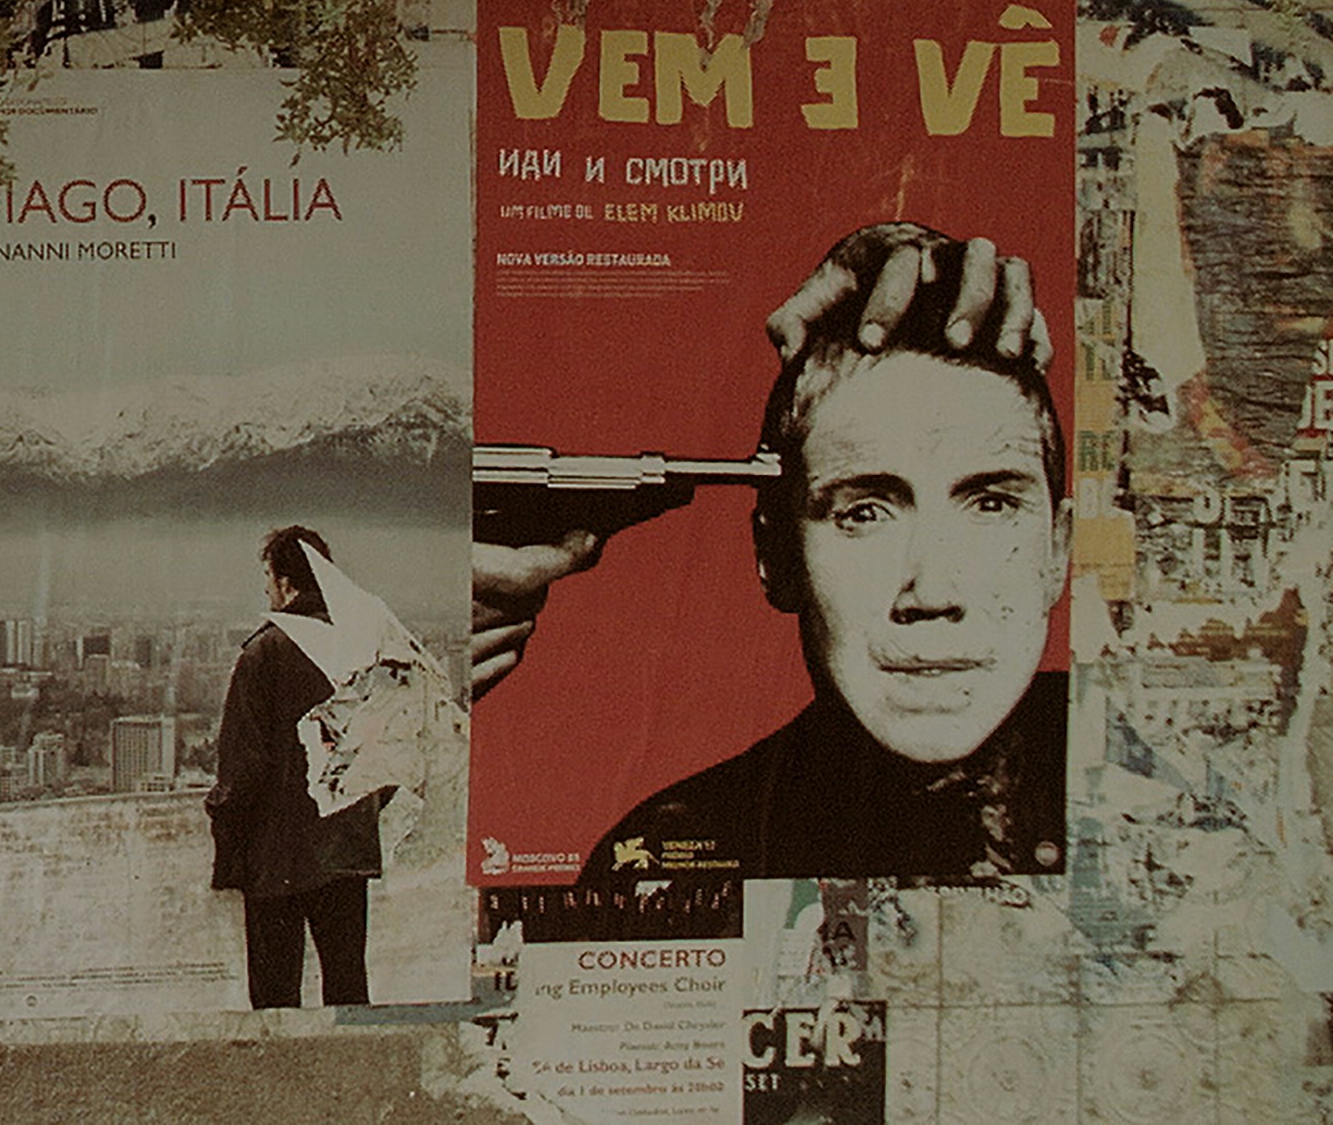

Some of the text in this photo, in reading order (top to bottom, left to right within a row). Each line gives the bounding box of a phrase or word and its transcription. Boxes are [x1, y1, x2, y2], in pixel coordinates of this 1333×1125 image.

[498, 25, 754, 130] VEM
[913, 3, 1061, 138] VÊ
[498, 148, 749, 196] ИДИ И СМОТРИ
[178, 165, 344, 224] ITÁLIA
[526, 204, 572, 220] FILME
[604, 202, 659, 223] ELEM
[77, 240, 177, 263] MORETTI
[496, 251, 672, 267] NOVA VERSÃO RESTAURADA
[577, 948, 727, 970] CONCERTO
[568, 978, 669, 999] Employees
[673, 975, 726, 993] Choir
[555, 1059, 576, 1075] de
[579, 1057, 632, 1075] Lisboa,
[634, 1057, 679, 1075] Largo
